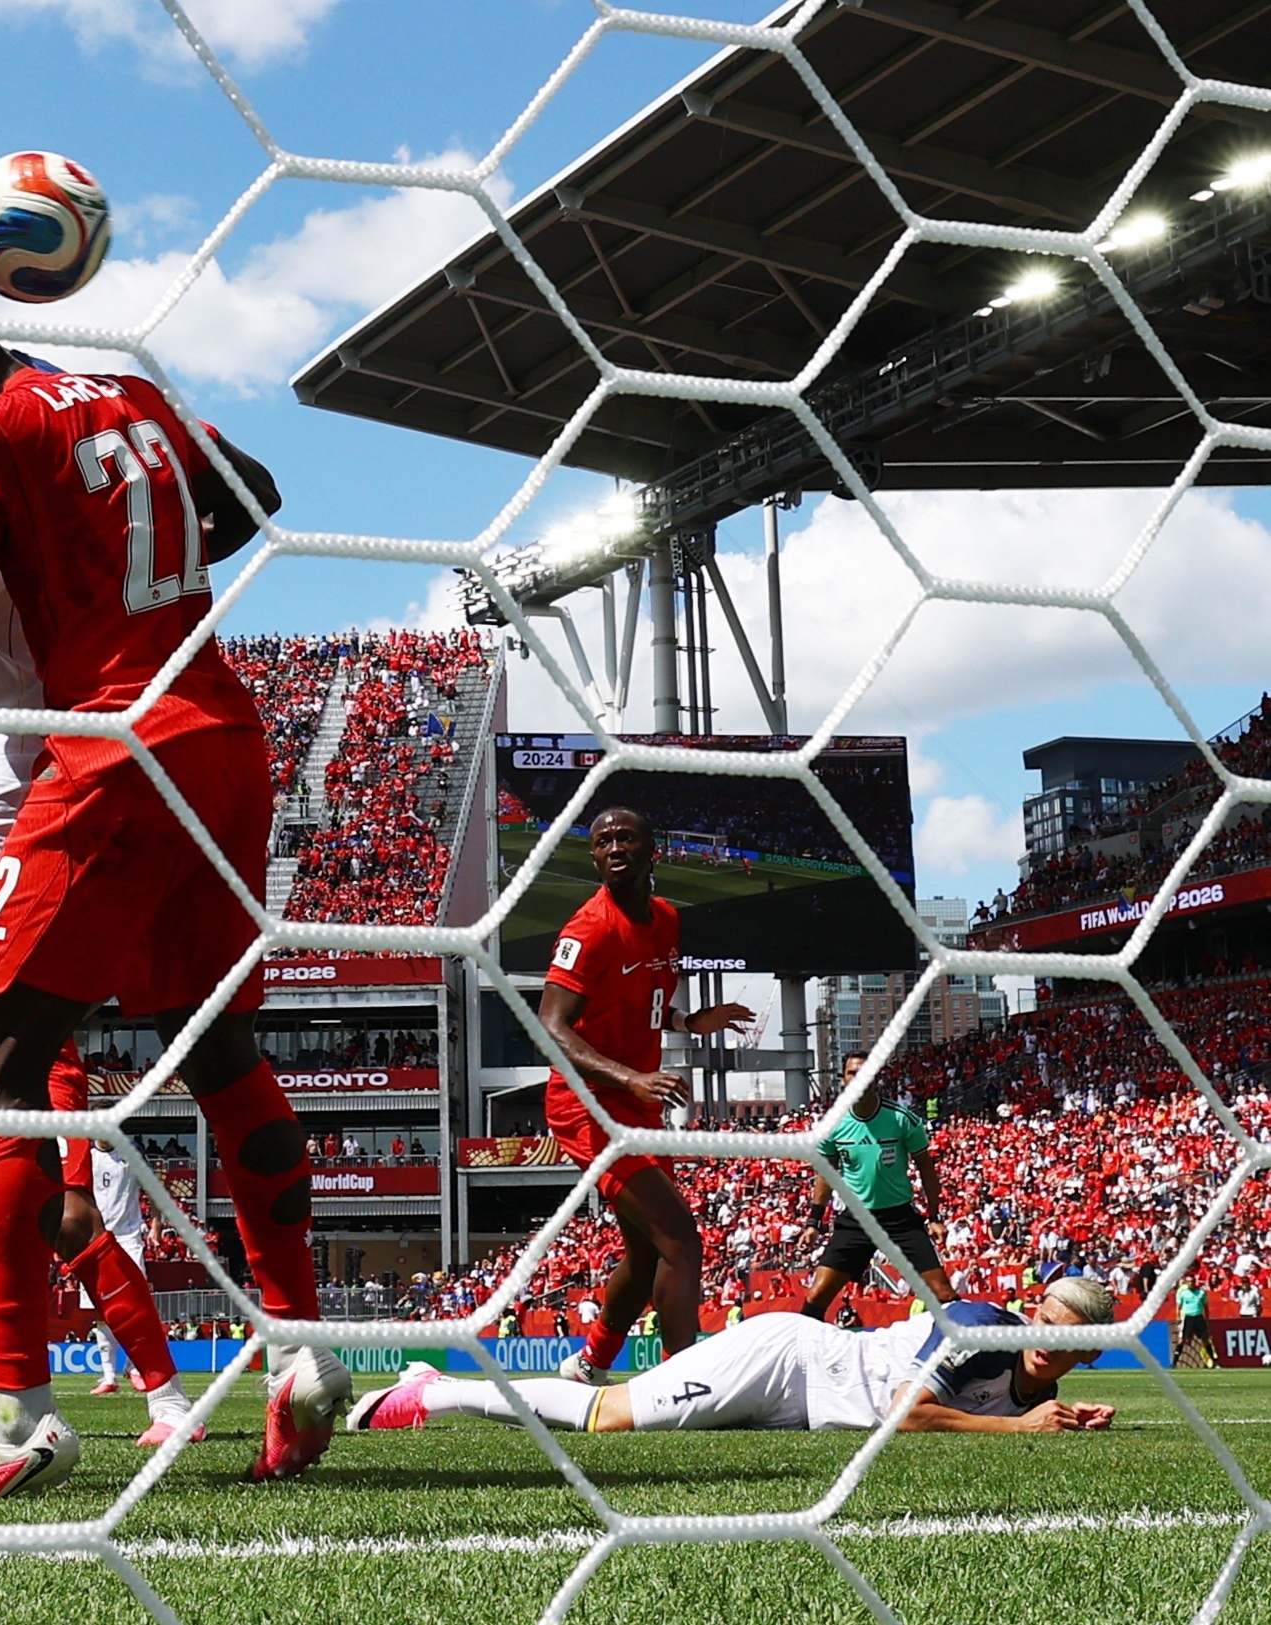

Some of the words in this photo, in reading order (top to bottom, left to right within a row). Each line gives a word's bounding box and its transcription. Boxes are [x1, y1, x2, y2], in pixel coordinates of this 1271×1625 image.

[74, 419, 211, 616] 22
[522, 753, 564, 767] 20:24
[765, 853, 790, 866] GLOBAL
[792, 857, 822, 871] ENERGY
[823, 861, 862, 876] PARTNER
[1080, 910, 1106, 930] FIFA
[1178, 884, 1224, 909] 2026
[264, 968, 280, 981] UP
[281, 966, 337, 981] 2026
[650, 988, 664, 1030] 8
[273, 1073, 389, 1088] ORONTO
[103, 1172, 110, 1188] 6
[311, 1173, 374, 1192] WorldCup
[496, 1338, 572, 1371] aramco
[1225, 1329, 1271, 1357] FIFA
[340, 1346, 402, 1372] aramco
[672, 1381, 712, 1405] 4
